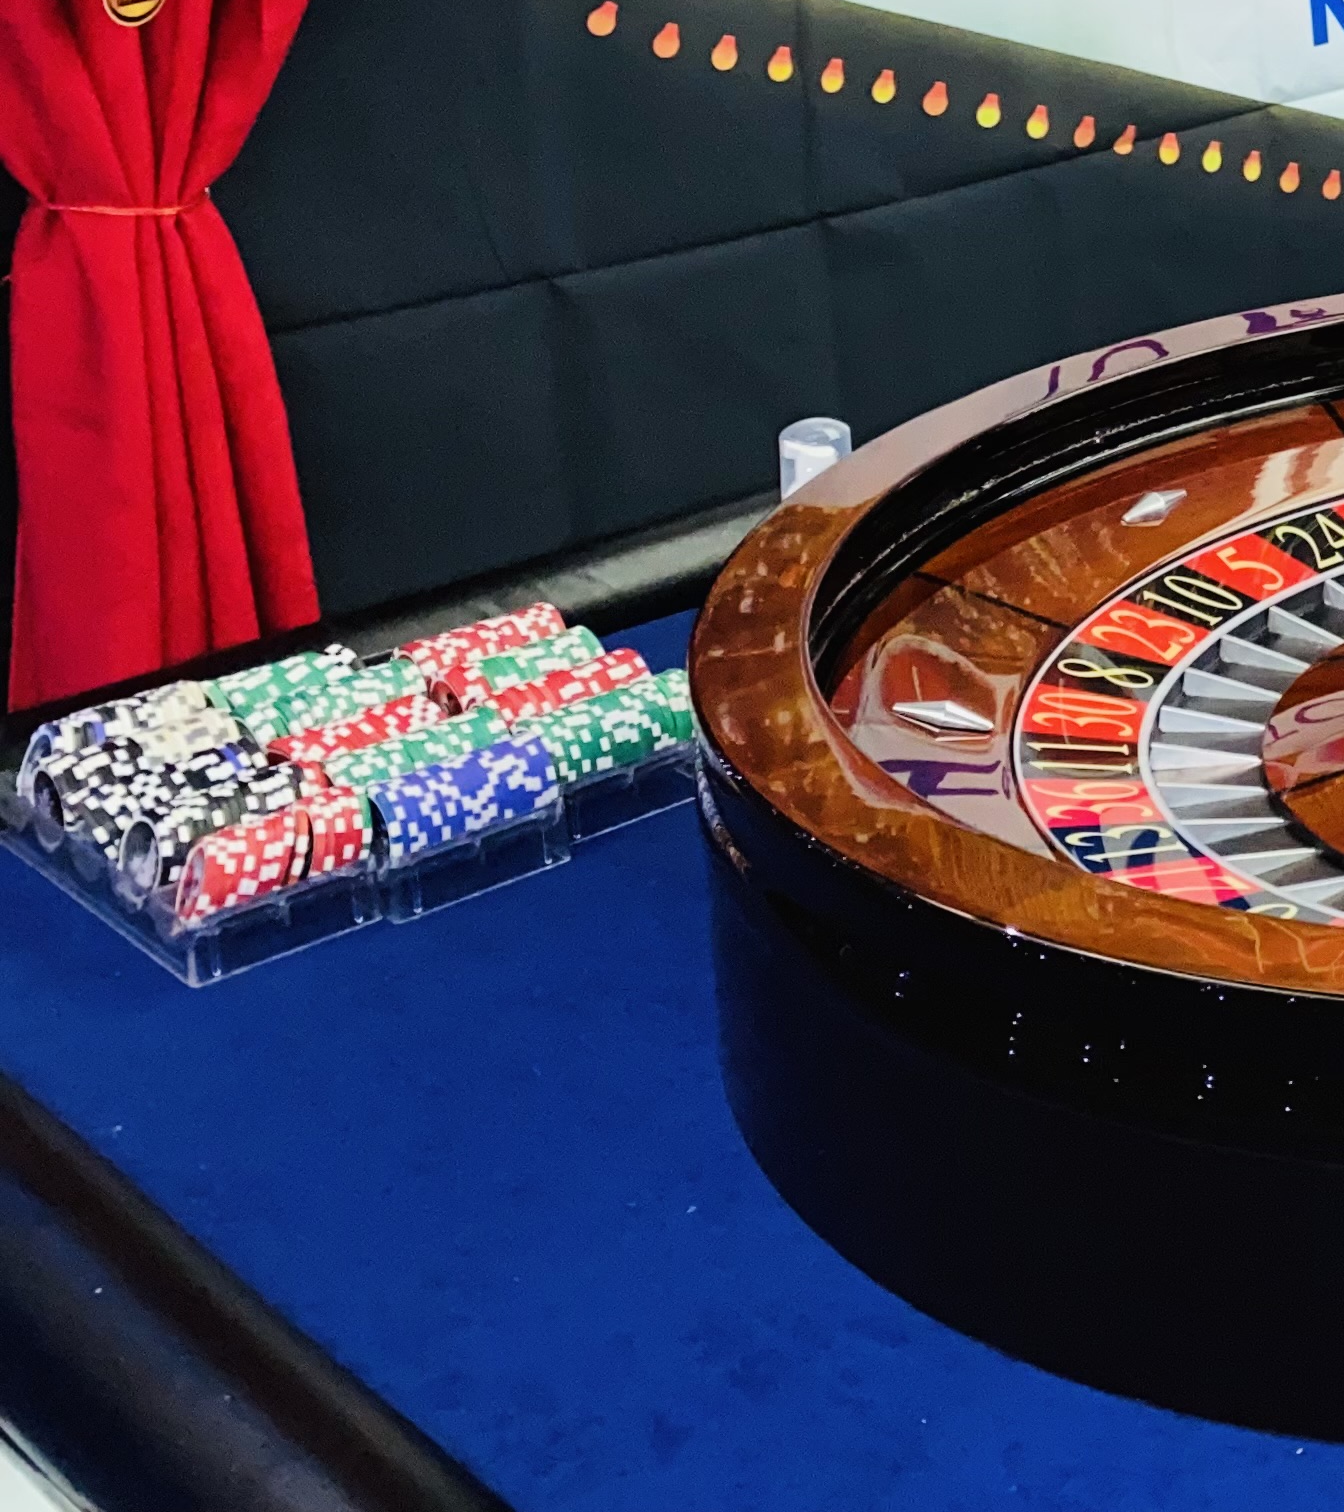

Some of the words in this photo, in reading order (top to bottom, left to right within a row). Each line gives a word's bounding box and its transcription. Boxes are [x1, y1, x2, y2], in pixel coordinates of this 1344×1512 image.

[1216, 546, 1284, 591] 5
[1142, 574, 1243, 628] 10
[1090, 609, 1196, 661] 23
[1057, 658, 1154, 688] 8
[1031, 692, 1138, 737] 30
[1026, 741, 1133, 775] 11
[1031, 781, 1154, 820] 36
[1064, 825, 1189, 863] 13
